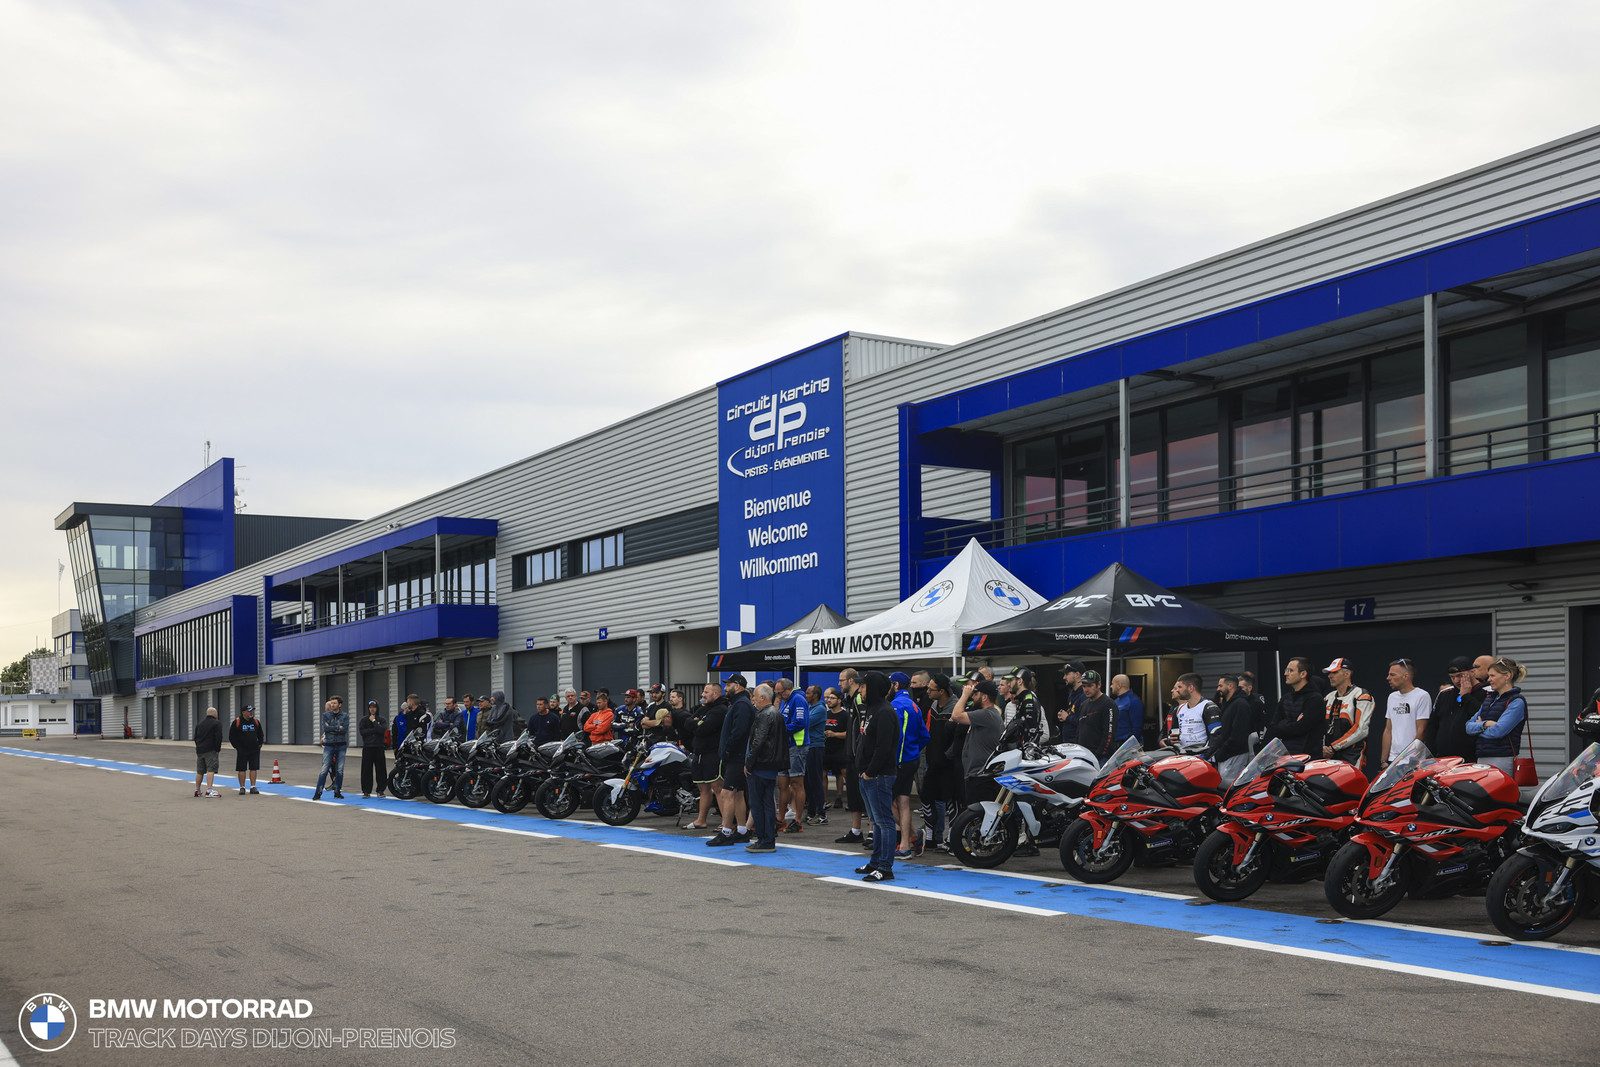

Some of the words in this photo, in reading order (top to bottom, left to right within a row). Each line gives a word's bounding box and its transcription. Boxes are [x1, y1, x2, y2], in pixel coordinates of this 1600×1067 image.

[727, 395, 771, 421] circuit
[780, 377, 830, 403] karting
[744, 442, 775, 459] dijon
[744, 464, 769, 478] PISTES
[774, 448, 830, 471] ÉVÉNEMENTIEL
[744, 489, 812, 520] Bienvenue
[748, 522, 808, 548] Welcome
[740, 552, 818, 580] Willkommen
[1351, 603, 1367, 616] 17
[811, 638, 845, 656] BMW
[849, 630, 934, 653] MOTORRAD
[1055, 632, 1099, 641] bmc-moto.com
